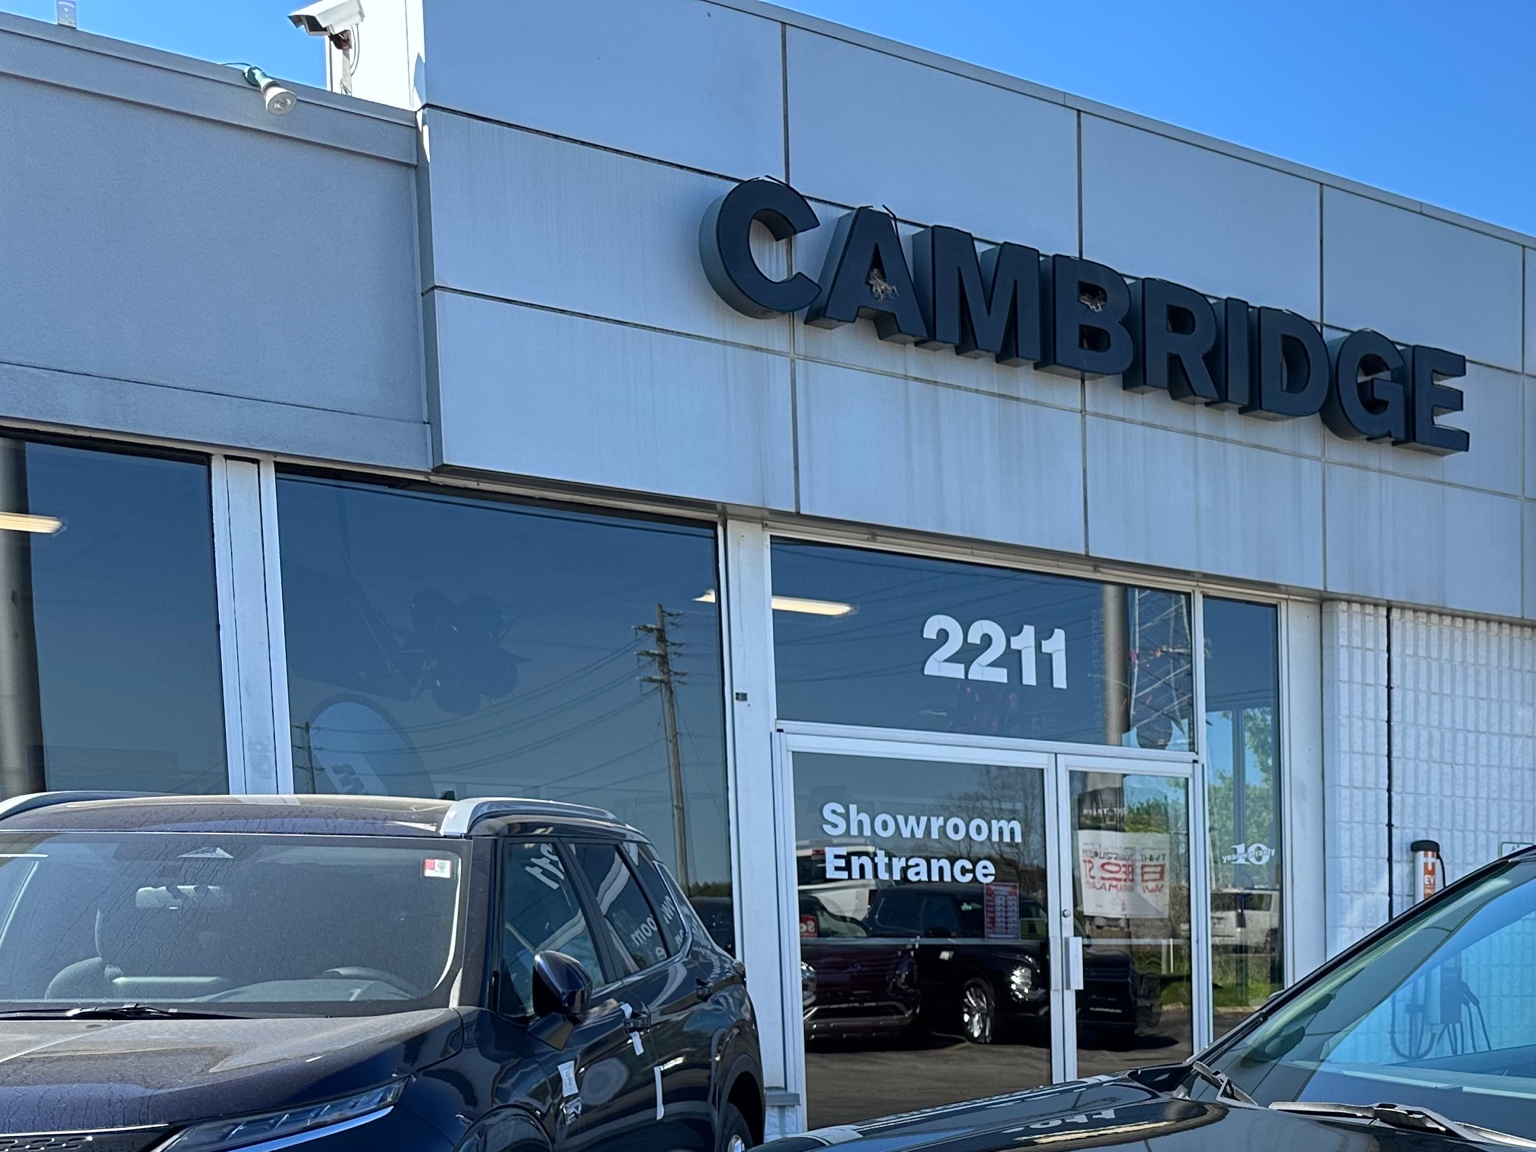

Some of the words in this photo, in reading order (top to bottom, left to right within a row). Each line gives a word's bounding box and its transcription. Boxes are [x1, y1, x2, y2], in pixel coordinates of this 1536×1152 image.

[699, 177, 1470, 455] CAMBRIDGE
[922, 613, 1068, 690] 2211
[822, 801, 1022, 843] Showroom
[824, 846, 996, 884] Entrance
[1230, 842, 1270, 865] 10
[1424, 874, 1436, 885] EV
